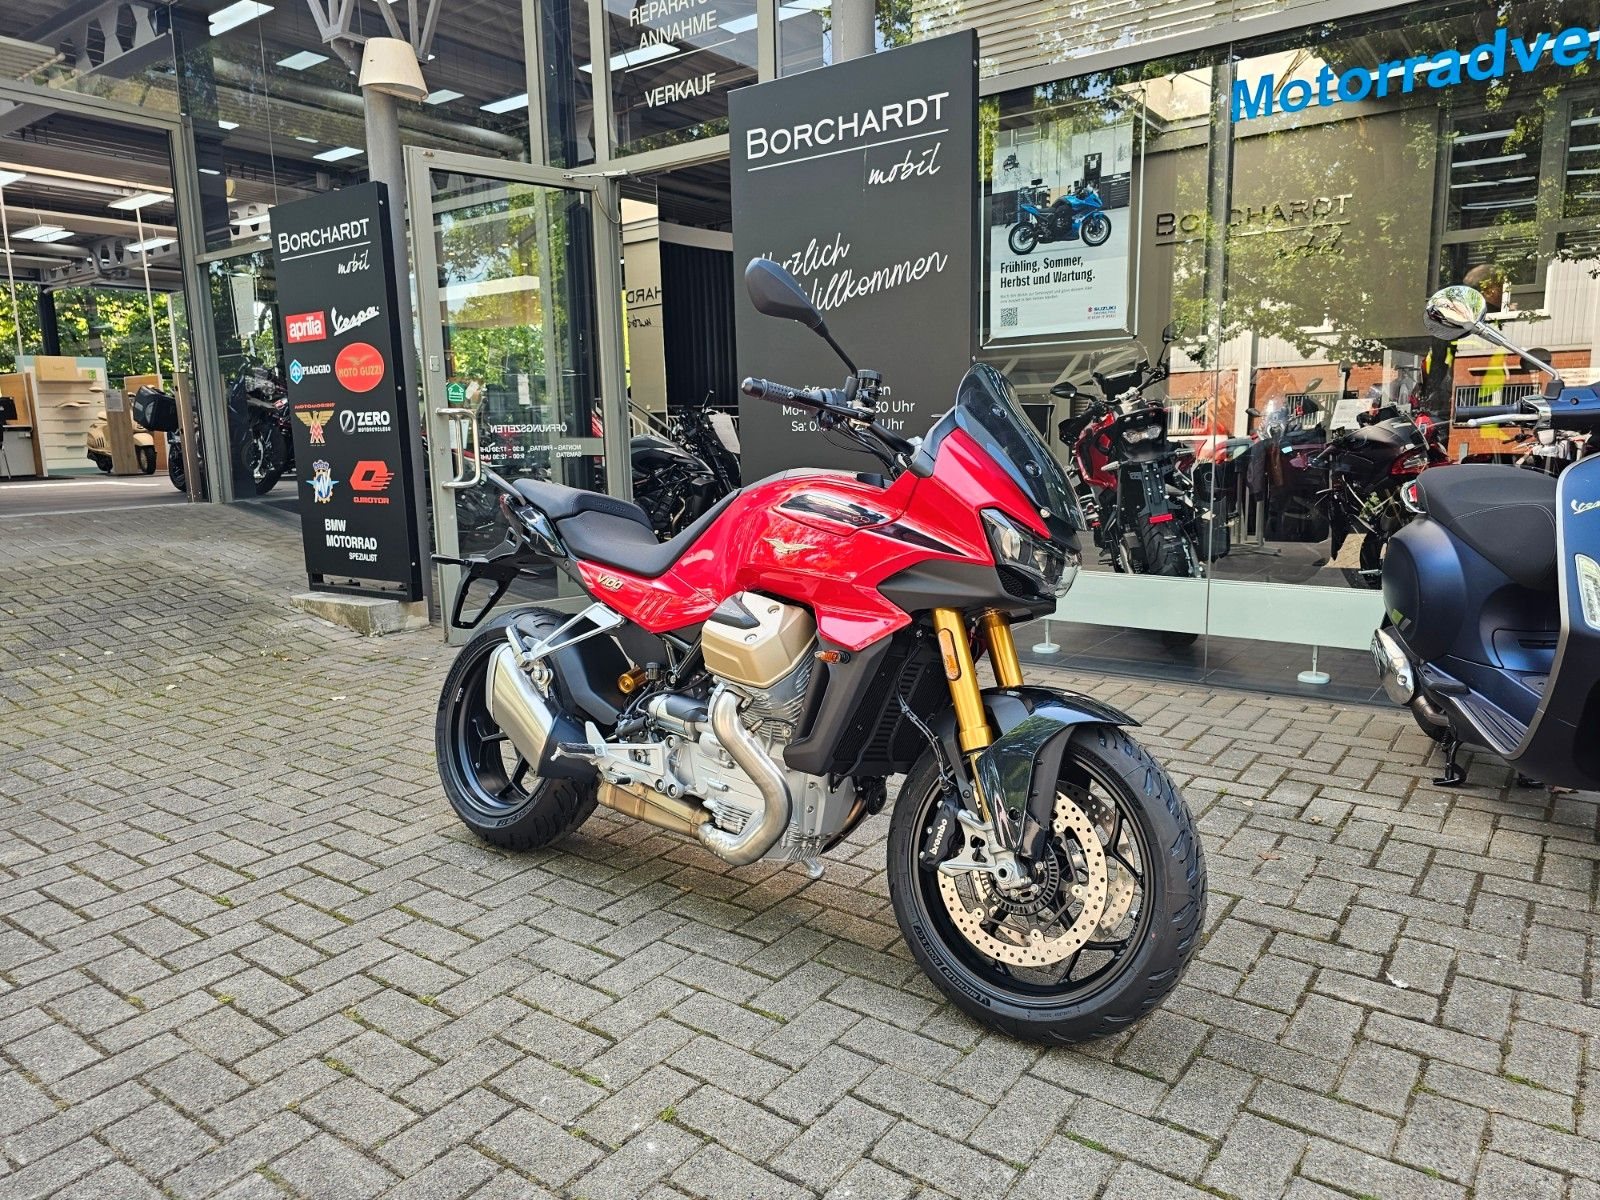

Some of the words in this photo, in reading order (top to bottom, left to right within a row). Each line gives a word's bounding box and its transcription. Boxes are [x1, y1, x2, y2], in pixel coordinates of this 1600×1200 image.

[629, 0, 713, 27] REPARA
[639, 10, 718, 50] ANNAHME
[1232, 25, 1600, 123] Motorradve
[645, 73, 717, 108] VERKAUF
[746, 91, 949, 160] BORCHARDT
[868, 142, 941, 185] mobil
[278, 218, 370, 254] BORCHARDT
[337, 250, 370, 275] mobil
[761, 233, 850, 276] rzlich
[1000, 260, 1040, 274] Frühling,
[1043, 256, 1083, 270] Sommer,
[799, 252, 948, 311] illkommen
[1000, 275, 1030, 288] Herbst
[1033, 273, 1050, 285] und
[1053, 268, 1096, 283] Wartung.
[289, 315, 323, 340] aprilia
[302, 364, 331, 376] PIAGGIO
[338, 368, 358, 378] MOTO
[360, 365, 382, 377] GUZZI
[356, 410, 391, 426] ZERO
[892, 400, 916, 413] Uhr
[325, 518, 346, 532] BMW
[326, 534, 378, 550] MOTORRAD
[349, 552, 377, 562] SPEZIALIST
[929, 818, 948, 856] brembo
